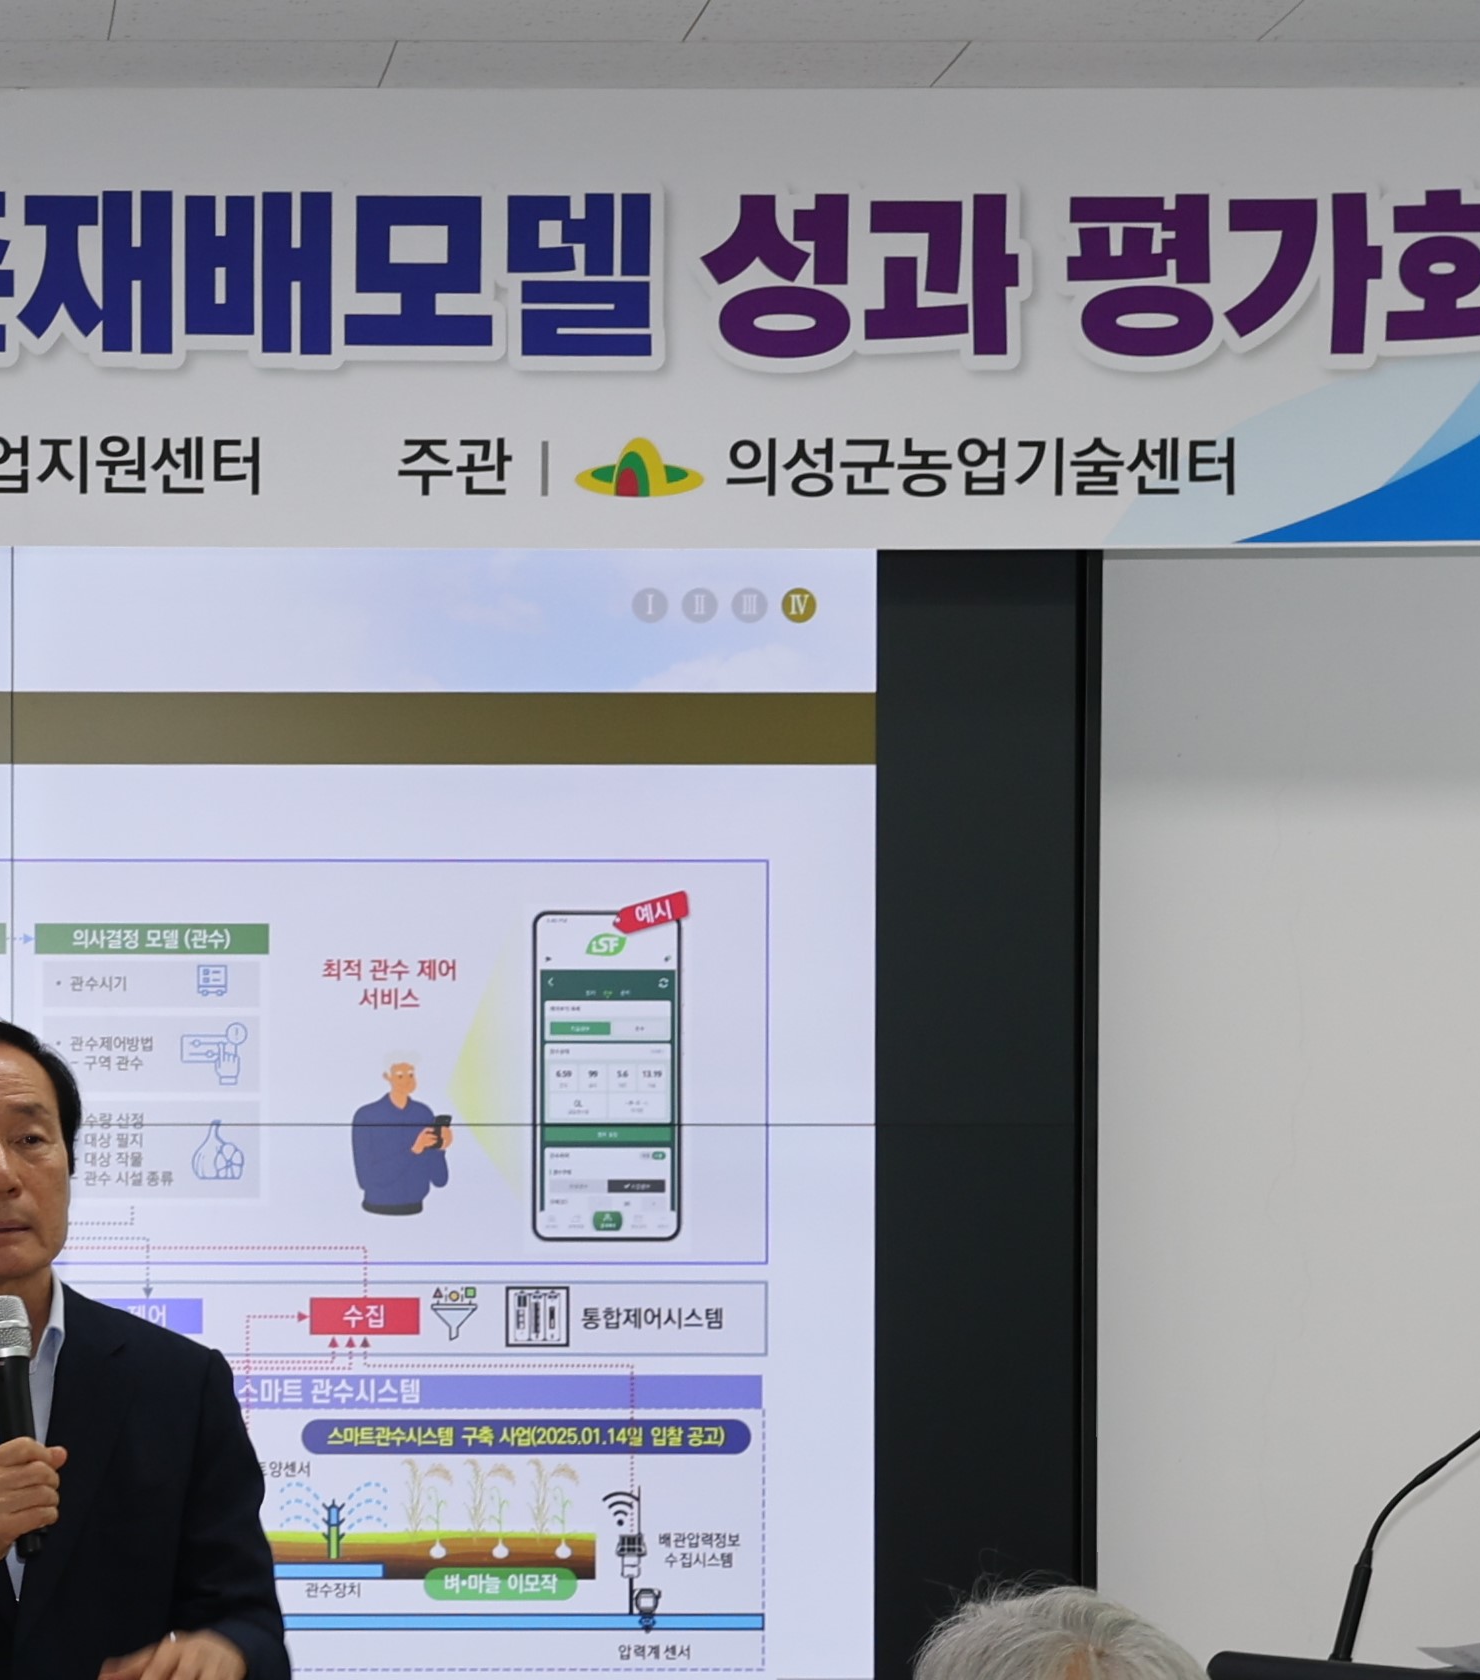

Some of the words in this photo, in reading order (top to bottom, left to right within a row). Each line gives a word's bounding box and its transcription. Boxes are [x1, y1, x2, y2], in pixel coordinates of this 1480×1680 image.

[703, 189, 1020, 359] 성과
[398, 432, 511, 498] 주관
[726, 430, 1238, 499] 의성군농업기술센터
[635, 899, 673, 924] 예시
[73, 928, 139, 950] 의사결정
[146, 929, 179, 949] 모델
[184, 928, 231, 951] (관수)
[323, 959, 362, 980] 최적
[369, 959, 410, 980] 관수
[417, 959, 457, 980] 제어
[70, 976, 127, 992] 관수시기
[359, 988, 420, 1009] 서비스
[70, 1036, 153, 1052] 관수제어방법
[83, 1057, 111, 1071] 구역
[116, 1057, 144, 1071] 관수
[84, 1172, 111, 1186] 관수
[115, 1172, 143, 1186] 시설
[343, 1305, 385, 1328] 수집
[581, 1307, 723, 1330] 통합제어시스템
[238, 1379, 303, 1403] 스마트
[311, 1378, 420, 1403] 관수시스템
[327, 1427, 454, 1447] 스마트관수시스템
[461, 1427, 494, 1447] 구축
[651, 1427, 683, 1447] 입찰
[687, 1427, 725, 1447] 공고)
[658, 1533, 740, 1548] 배관압력정보
[664, 1554, 733, 1568] 수집시스템
[305, 1583, 361, 1599] 관수장치
[507, 1574, 558, 1594] 이모작
[618, 1645, 660, 1660] 압력계
[663, 1645, 691, 1660] 센서
